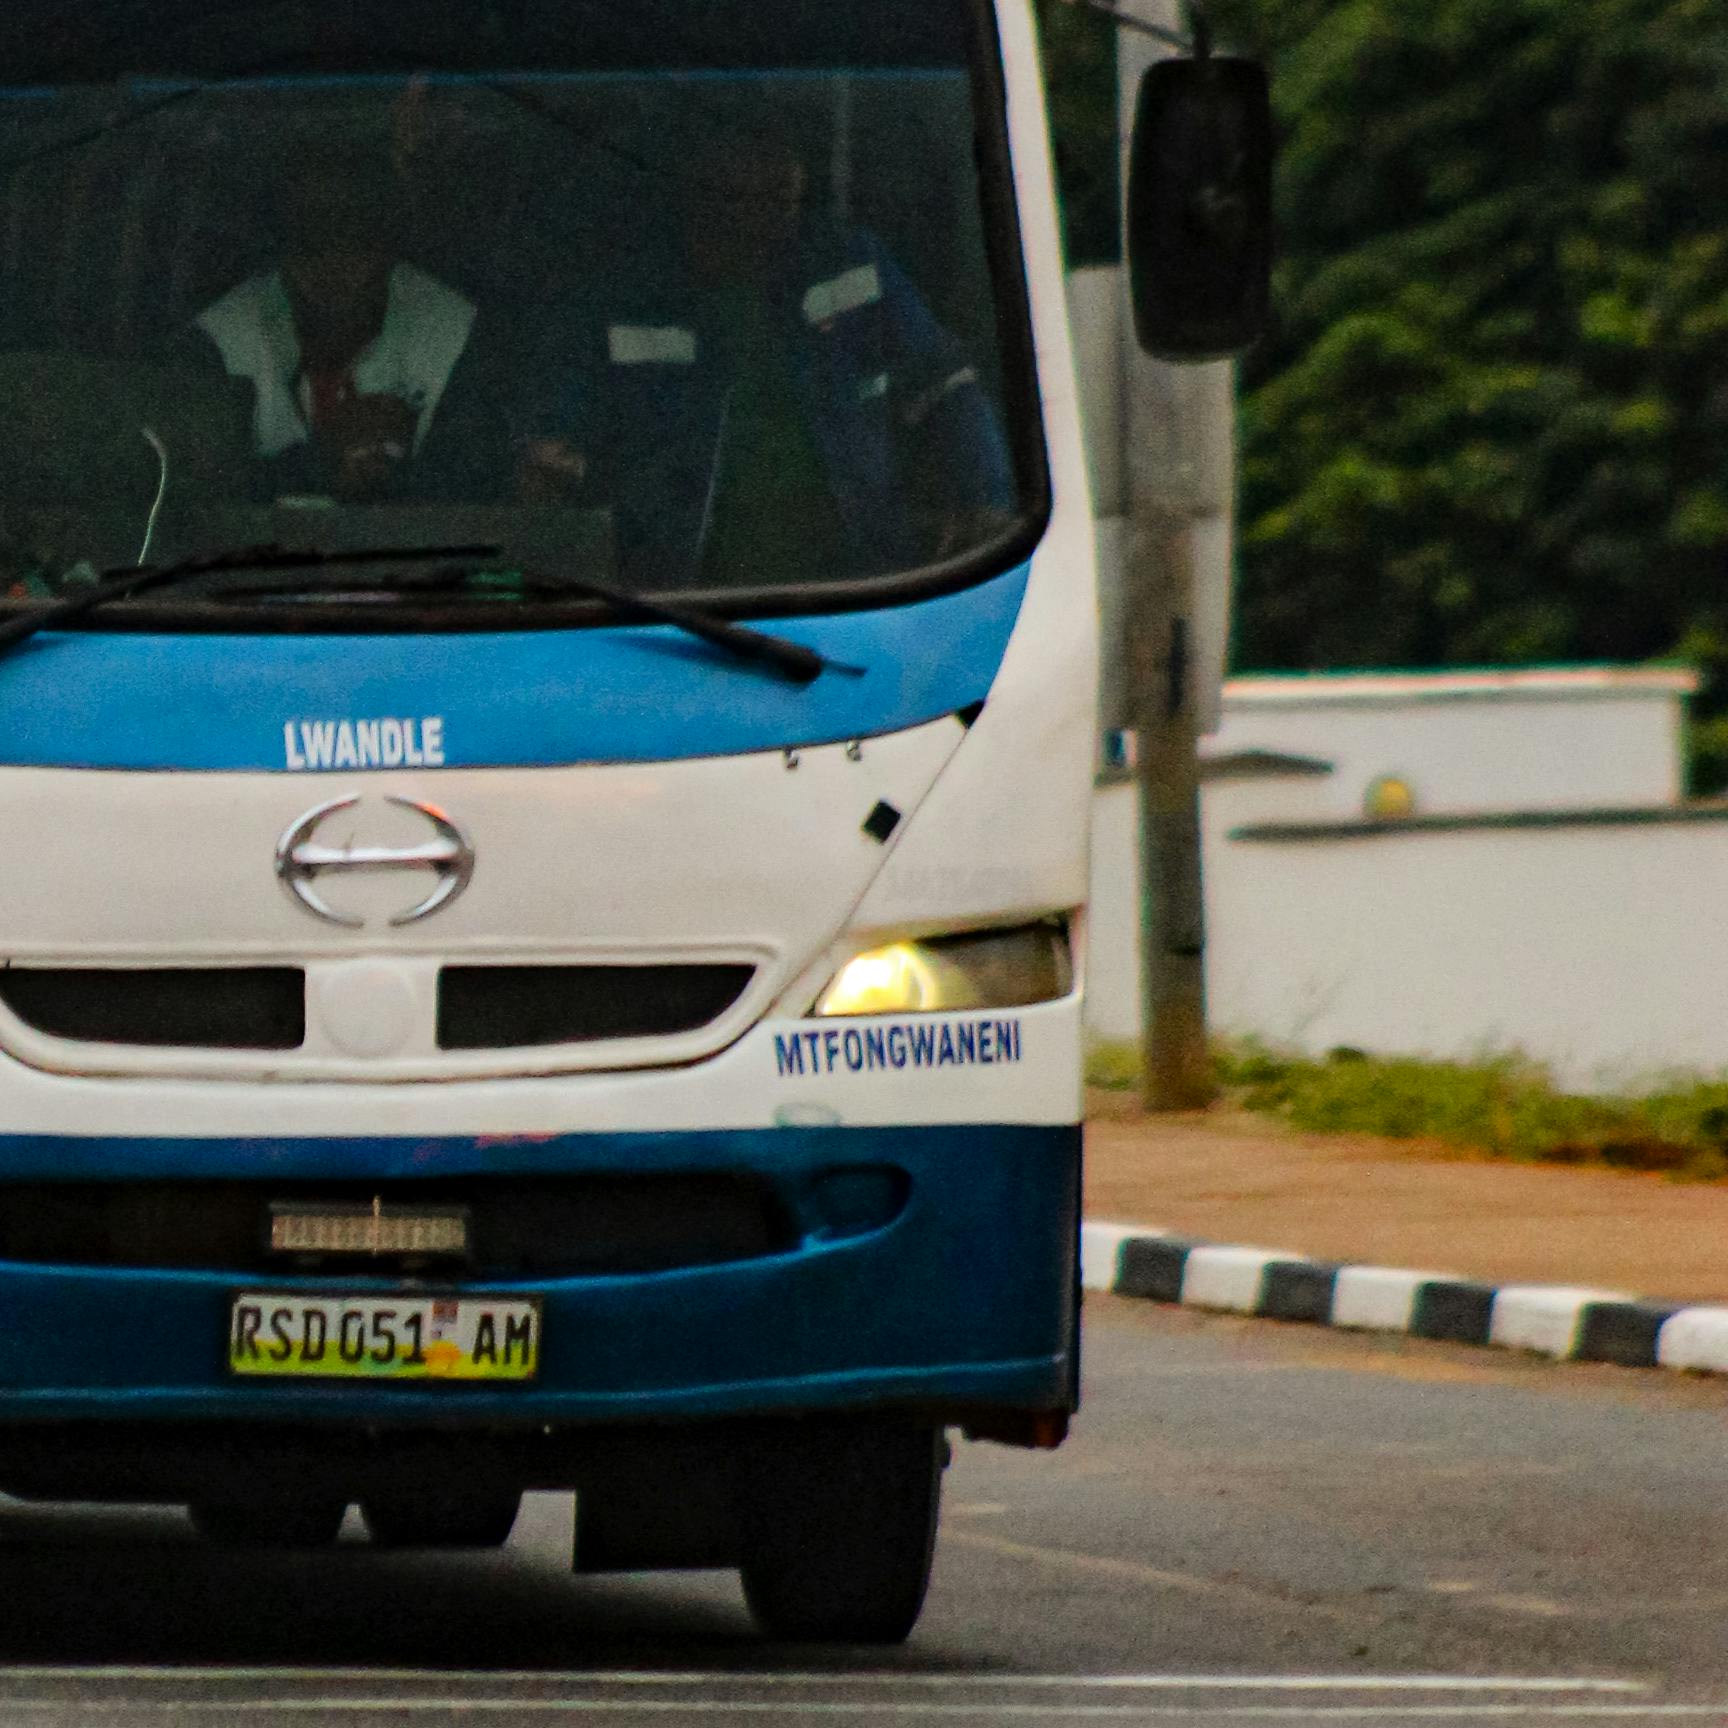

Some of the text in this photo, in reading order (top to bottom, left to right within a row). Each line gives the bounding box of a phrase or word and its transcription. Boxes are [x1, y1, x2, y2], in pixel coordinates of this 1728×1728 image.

[283, 717, 446, 771] LWANDLE
[774, 1018, 1021, 1076] MTFONGWANENI
[472, 1310, 532, 1365] AM
